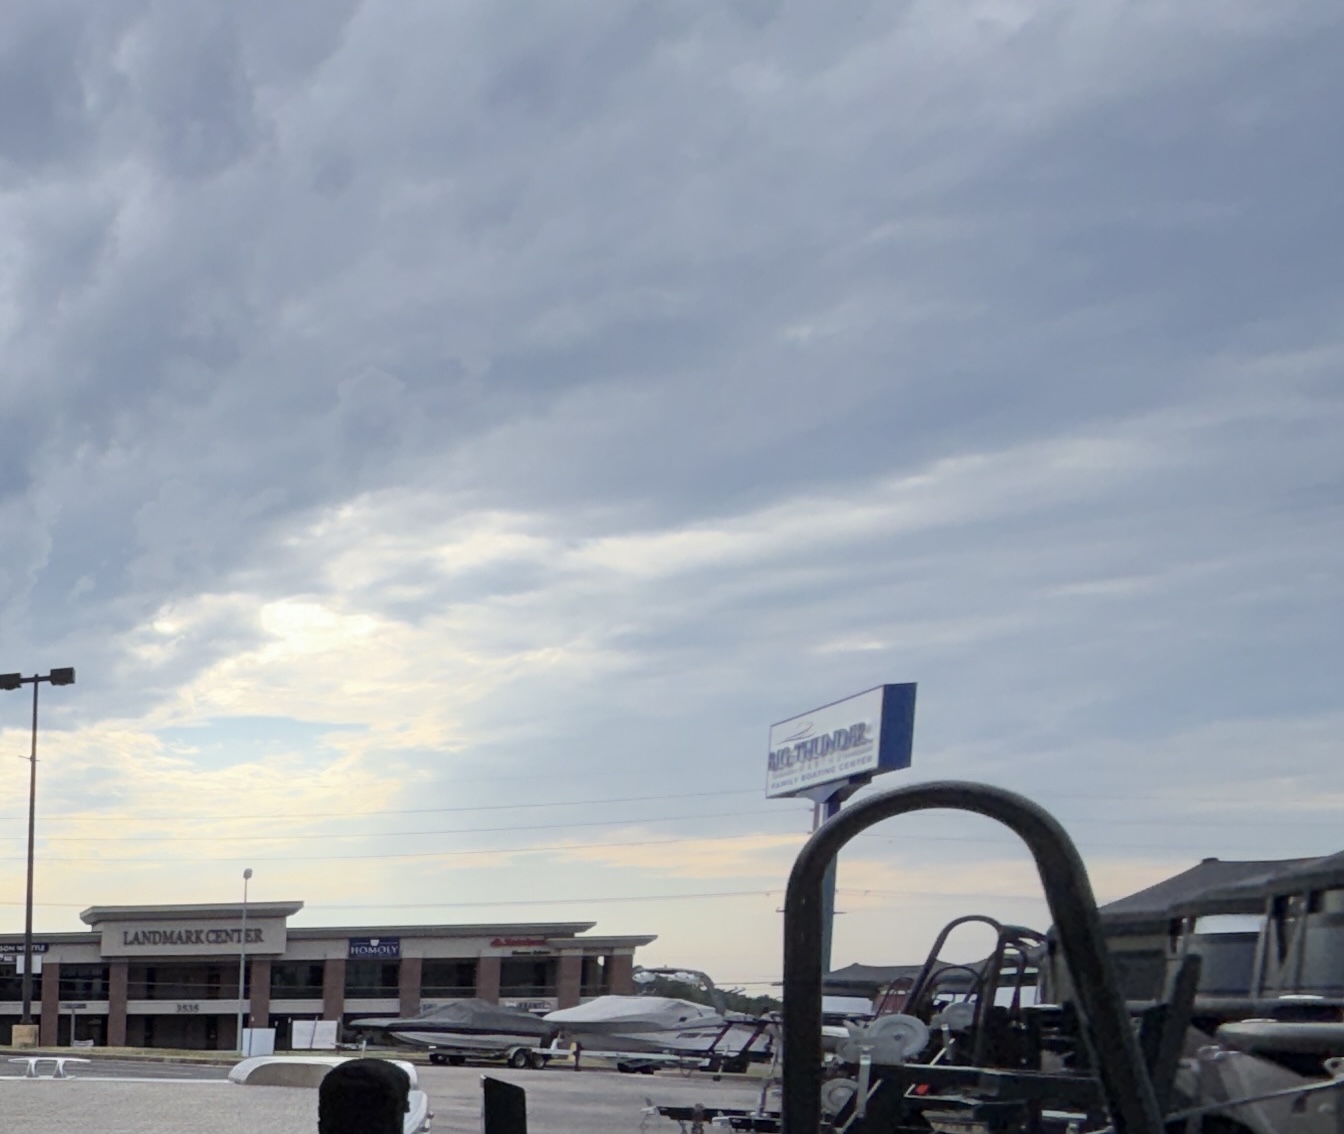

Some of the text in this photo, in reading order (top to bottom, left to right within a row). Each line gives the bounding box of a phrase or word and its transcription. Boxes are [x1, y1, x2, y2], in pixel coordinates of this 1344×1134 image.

[123, 928, 264, 946] LANDMARK CENTER
[350, 946, 398, 955] HOMOLY
[176, 1003, 200, 1013] 3535
